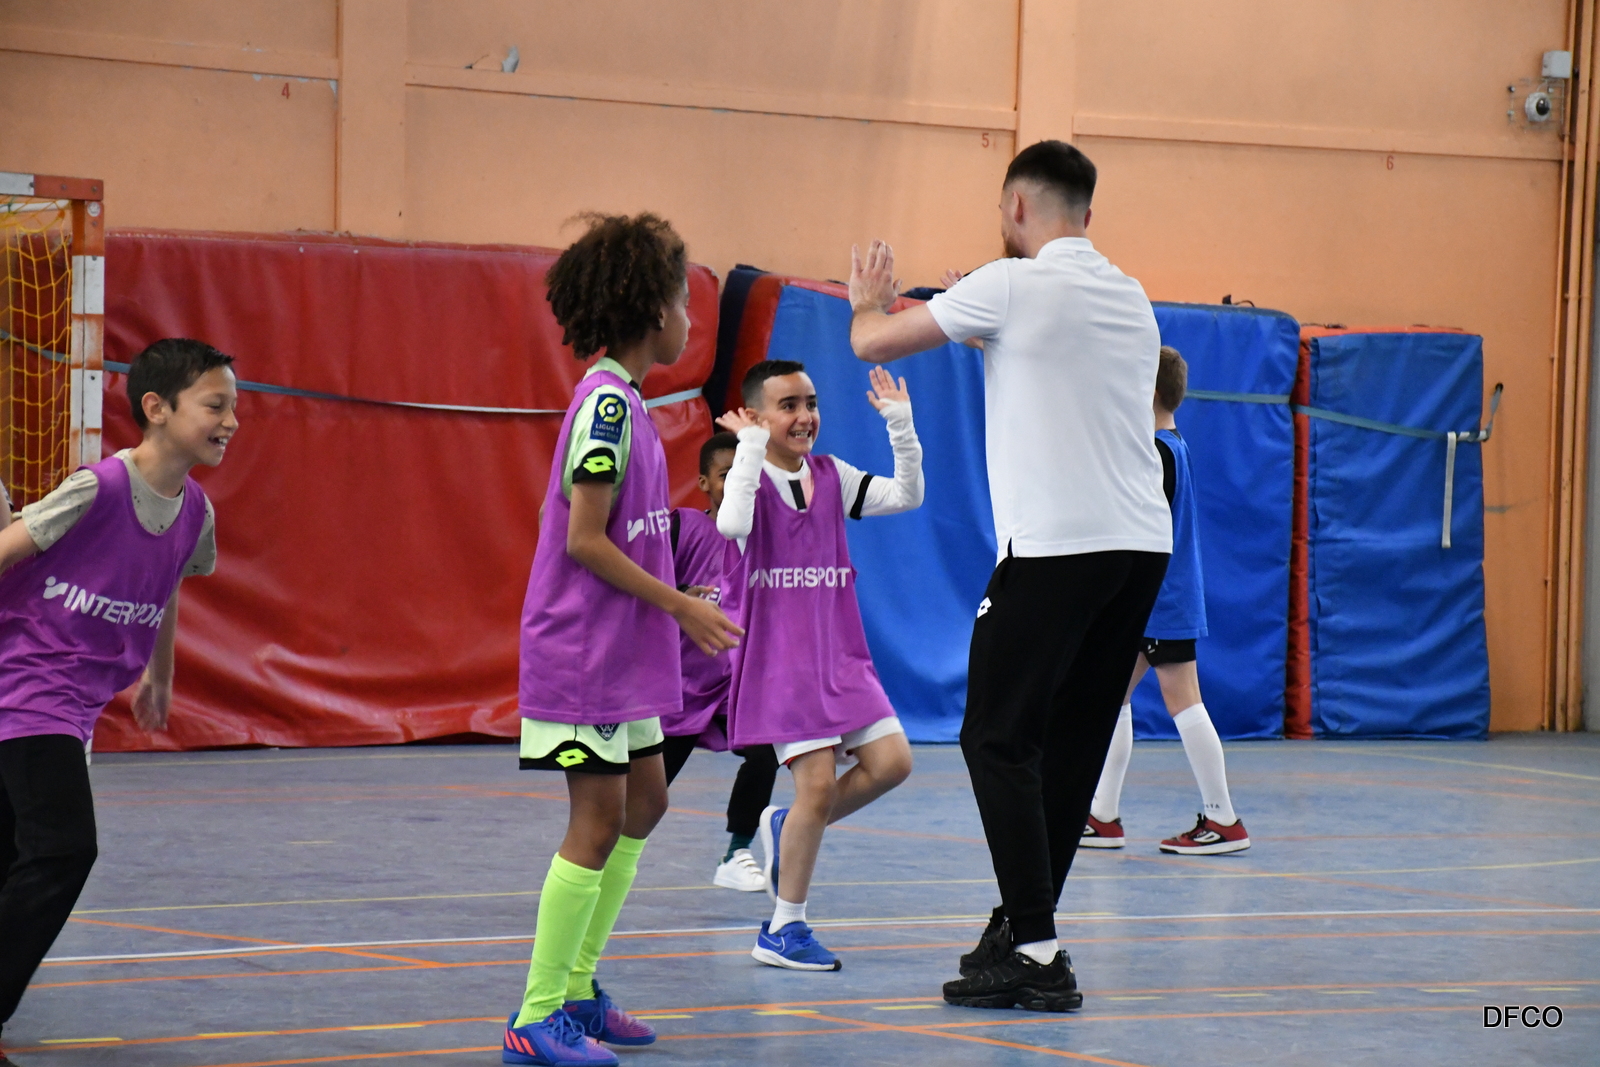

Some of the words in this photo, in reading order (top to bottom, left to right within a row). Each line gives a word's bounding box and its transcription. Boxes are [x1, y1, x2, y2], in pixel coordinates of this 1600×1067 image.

[281, 82, 291, 100] 4
[981, 132, 990, 148] 5
[1386, 155, 1395, 171] 6
